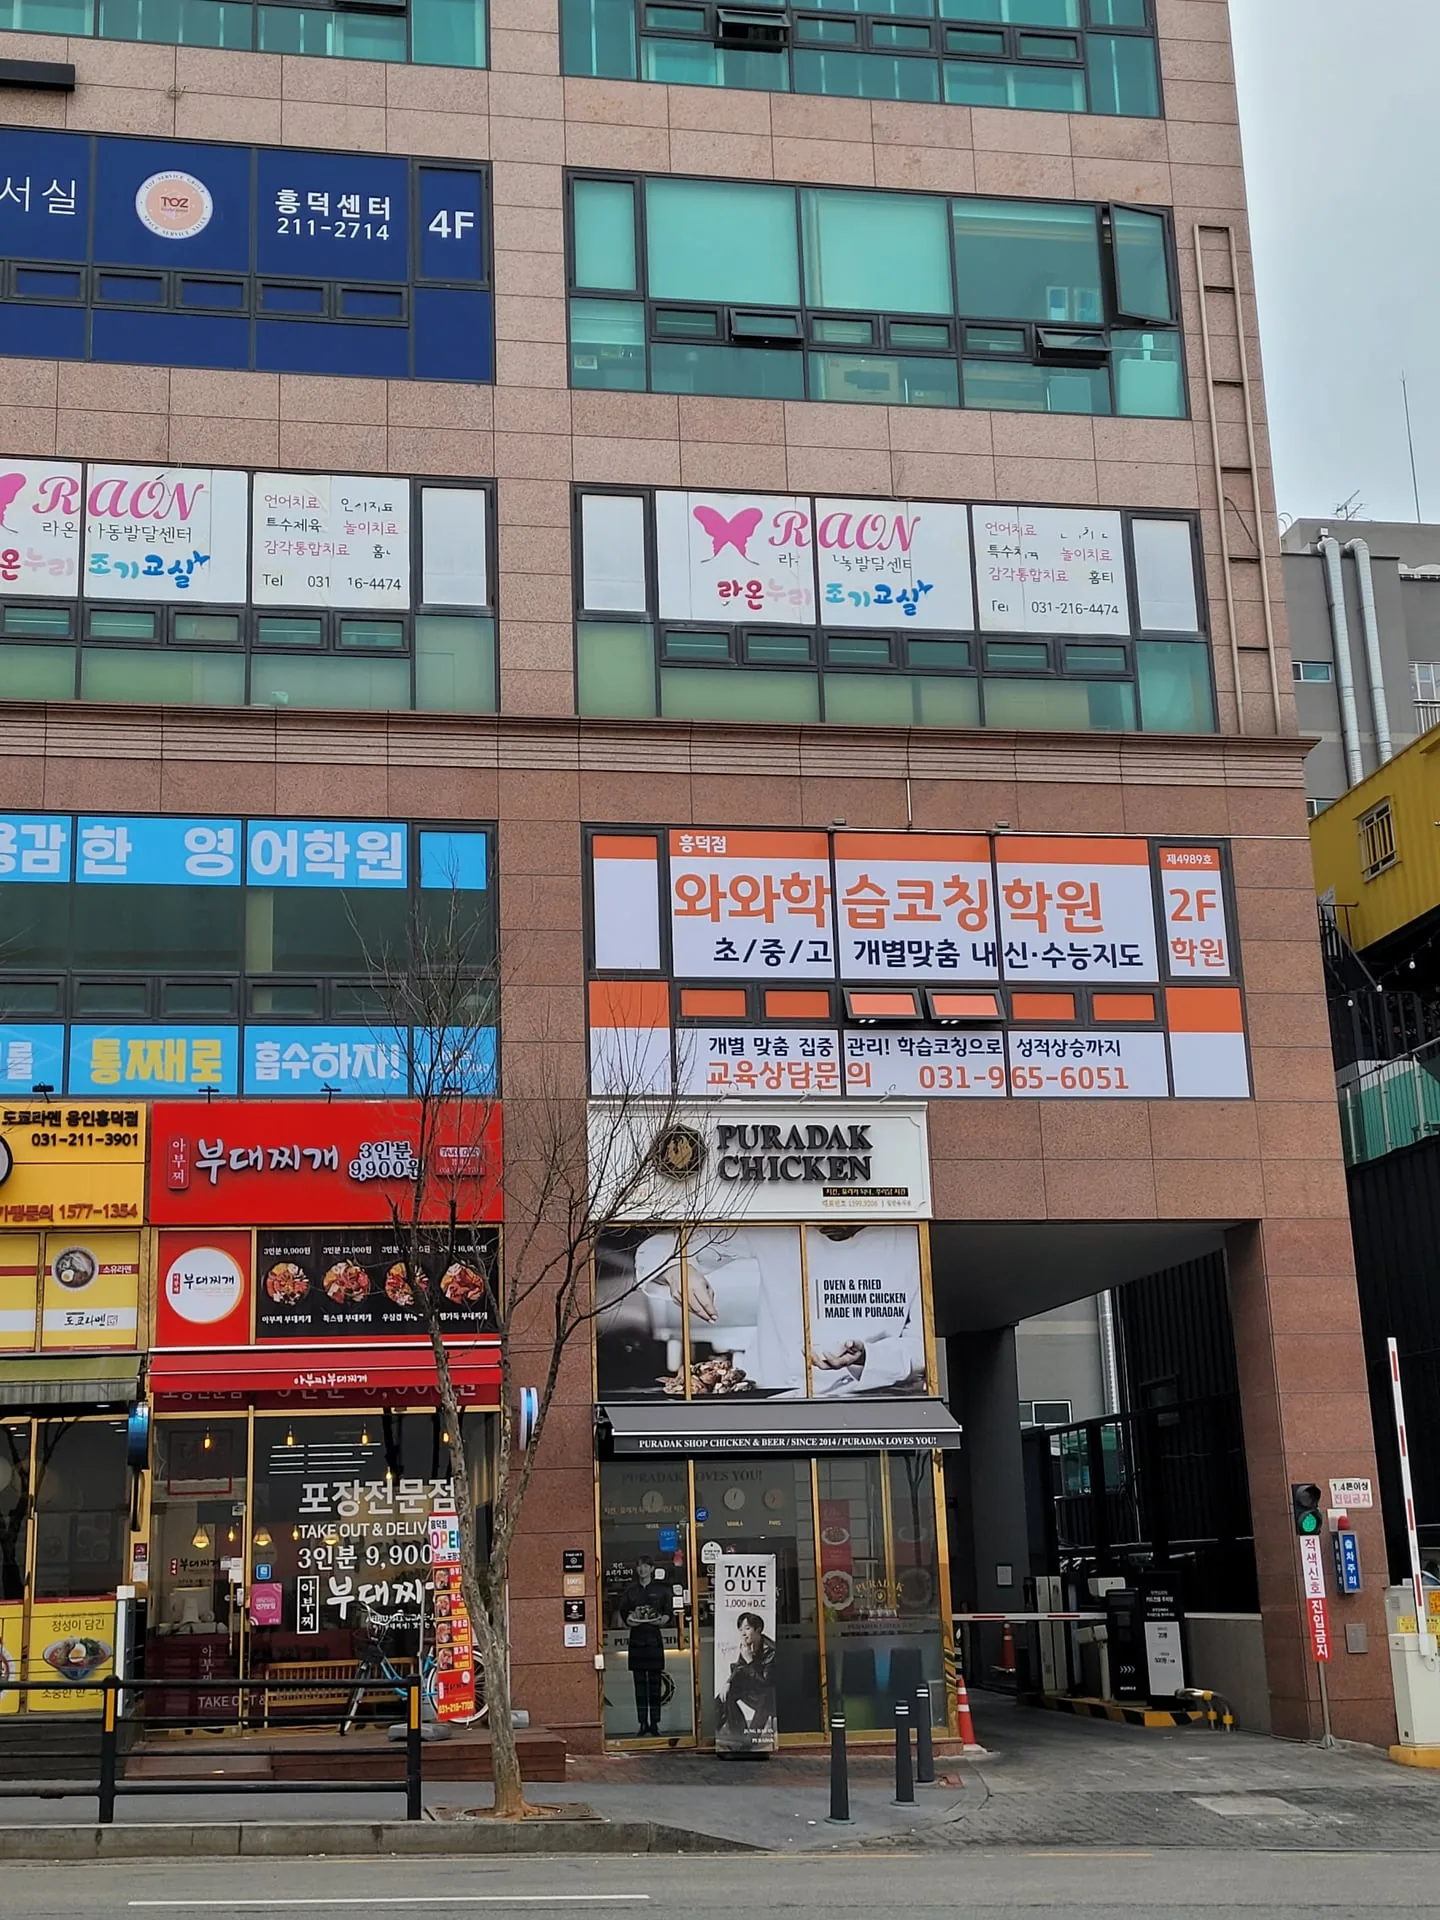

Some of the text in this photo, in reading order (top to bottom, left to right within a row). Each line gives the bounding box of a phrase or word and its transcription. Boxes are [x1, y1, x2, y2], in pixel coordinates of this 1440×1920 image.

[160, 196, 189, 208] TOZ
[275, 188, 391, 222] 흥덕센터
[276, 217, 390, 241] 211-2714
[428, 209, 475, 239] 4F
[32, 476, 204, 521] RAON
[264, 494, 320, 509] 언어치료
[42, 520, 79, 539] 라온
[344, 520, 399, 535] 놀이치료
[768, 510, 921, 551] RAON
[985, 522, 1037, 537] 언어치료
[264, 540, 391, 559] 감각통합치료 홈
[1060, 547, 1113, 562] 놀이치료
[89, 551, 195, 589] 조기교실
[988, 567, 1069, 583] 감각통합치료
[262, 573, 283, 587] Tel
[307, 575, 330, 588] 031
[825, 582, 919, 617] 조기교실
[1031, 601, 1119, 615] 031-216-4474
[679, 835, 727, 853] 흥덕점
[184, 827, 403, 881] 영어학원
[1166, 854, 1213, 866] 제4989호
[1169, 889, 1217, 922] 2F
[713, 938, 833, 967] 초/중/고
[854, 939, 960, 969] 개별맞춤
[1170, 938, 1225, 967] 학원
[709, 1036, 1121, 1058] 개별 맞춤 집중 관리! 학습코칭으로 성적상승까지
[0, 1040, 33, 1080] 를
[91, 1038, 222, 1084] 통째로
[255, 1040, 401, 1082] 흡수하자!
[707, 1060, 1129, 1091] 교육상담문의 031-965-6051
[32, 1133, 138, 1147] 031-211-3901
[717, 1124, 873, 1150] PURADAK
[360, 1141, 412, 1160] 3인분
[172, 1138, 186, 1183] 아부찌
[196, 1138, 338, 1185] 부대찌개
[349, 1160, 419, 1180] 9,900원
[717, 1155, 872, 1182] CHICKEN
[59, 1203, 138, 1219] 1577-1354
[184, 1273, 235, 1289] 부대찌개
[823, 1279, 881, 1290] OVEN & FRIED
[824, 1292, 906, 1304] PREMIUM CHICKEN
[825, 1306, 904, 1318] MADE IN PURADAK
[639, 1439, 683, 1448] PURADAK
[684, 1439, 708, 1447] SHOP
[710, 1438, 751, 1447] CHICKEN
[752, 1438, 760, 1446] &
[761, 1438, 785, 1447] BEER
[791, 1437, 817, 1446] SINCE
[818, 1437, 836, 1446] 2014
[842, 1437, 885, 1445] PURADAK
[886, 1436, 914, 1445] LOVES
[915, 1436, 937, 1445] YOU!
[697, 1471, 729, 1482] OVES
[298, 1478, 455, 1517] 포장전문점
[1335, 1494, 1370, 1505] 진입금지
[299, 1521, 428, 1538] TAKE OUT & DELIV
[298, 1544, 433, 1570] 3인분 9,900
[1305, 1538, 1322, 1594] 적색신호
[1344, 1539, 1357, 1586] 출차주의
[724, 1565, 767, 1578] TAKE
[724, 1580, 767, 1592] OUT
[301, 1580, 315, 1630] 아부찌
[327, 1576, 435, 1620] 부대찌
[52, 1619, 81, 1632] 정성이
[1311, 1600, 1329, 1660] 진입금지
[197, 1696, 230, 1709] TAKE
[231, 1695, 256, 1707] OT
